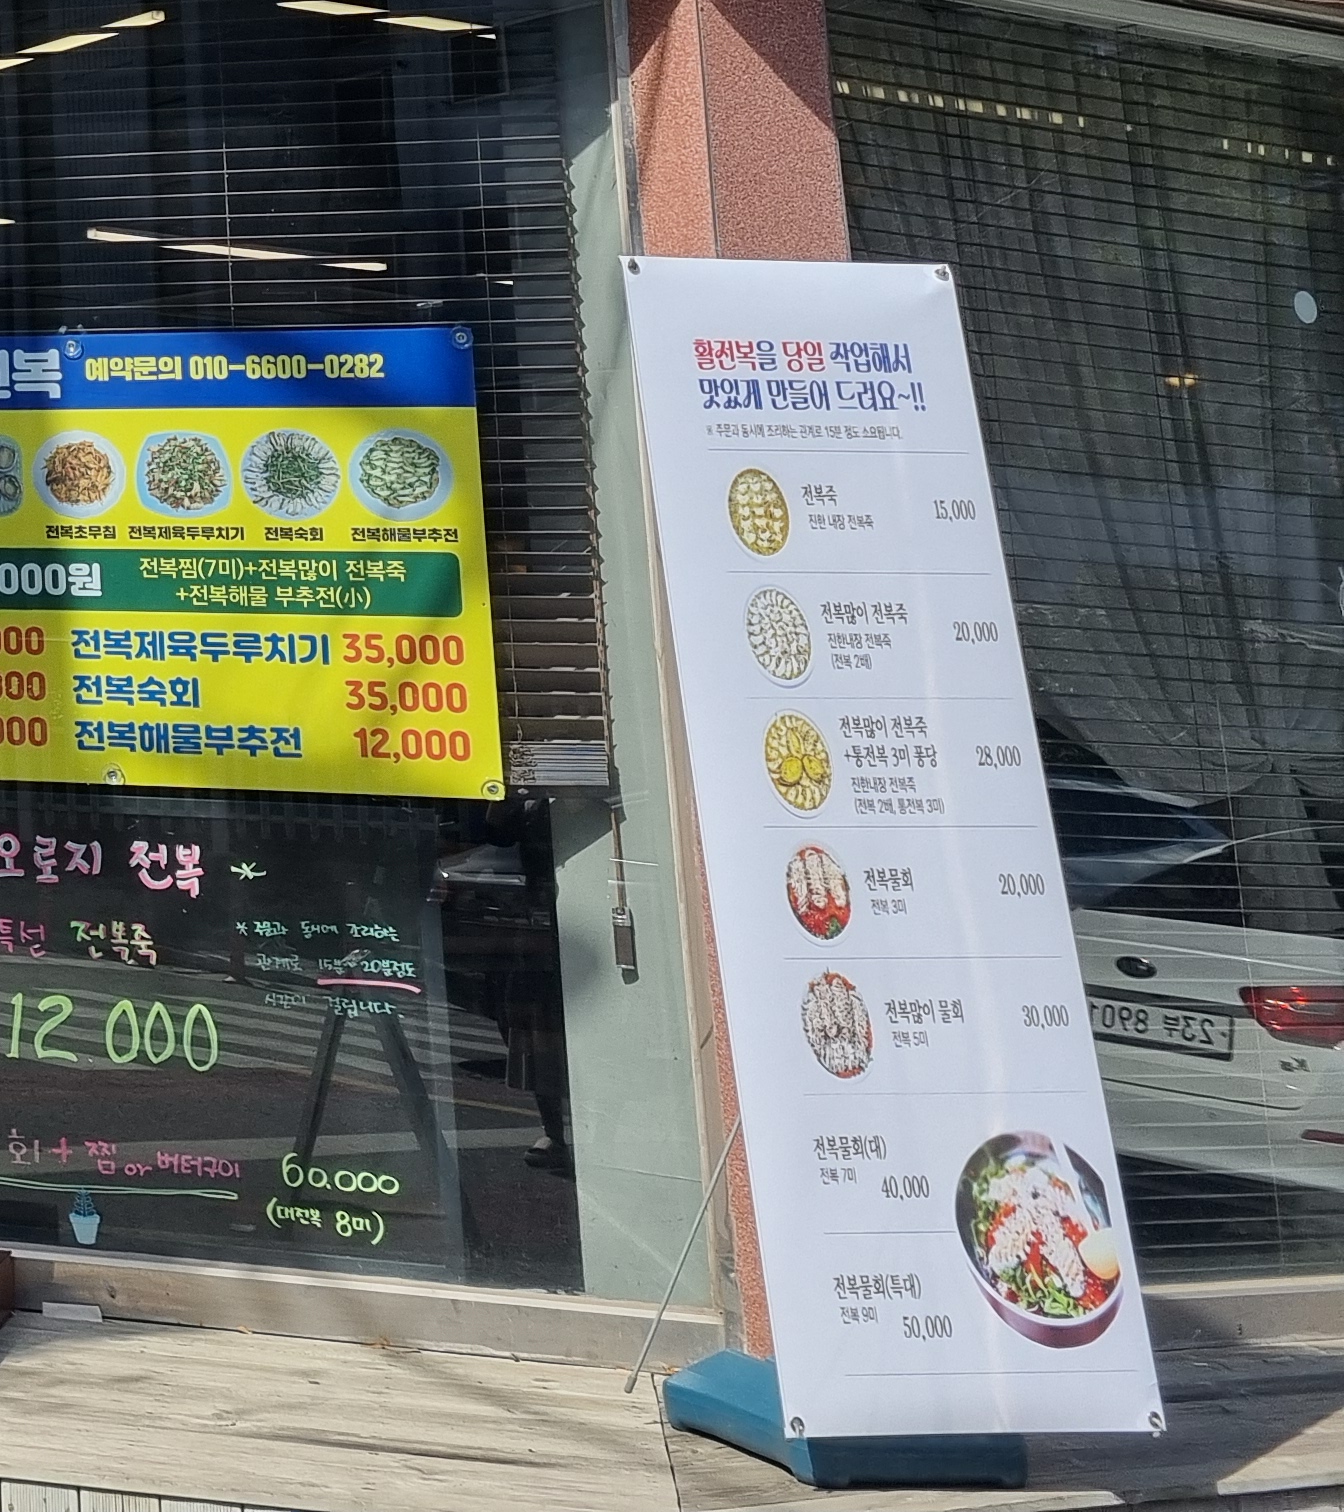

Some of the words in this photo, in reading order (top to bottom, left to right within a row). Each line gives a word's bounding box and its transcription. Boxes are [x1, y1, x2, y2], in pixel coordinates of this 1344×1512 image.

[85, 355, 182, 382] 예약문의
[190, 354, 385, 381] 010-6600-0282
[692, 338, 778, 372] 활전복을
[781, 341, 826, 373] 당일
[829, 342, 912, 374] 작업해서
[698, 378, 762, 410] 맛있게
[766, 378, 831, 411] 만들어
[837, 381, 927, 412] 드려요~!!
[800, 485, 838, 506] 전복죽
[933, 499, 977, 522] 15,000
[45, 524, 116, 540] 전복초무침
[128, 525, 245, 541] 전복제육두루치기
[264, 526, 324, 542] 전복숙회
[350, 527, 459, 544] 전복해물부추전
[847, 515, 874, 530] 전복죽
[140, 557, 339, 581] 전복찜(7미)+전복많이
[345, 559, 407, 583] 전복죽
[175, 585, 268, 607] +전복해물
[819, 602, 869, 625] 전복많이
[871, 602, 908, 625] 전복죽
[952, 621, 999, 645] 20,000
[70, 628, 331, 666] 전복제육두루치기
[342, 632, 464, 669] 35,000
[864, 633, 892, 649] 전복죽
[72, 674, 200, 709] 전복숙회
[345, 679, 468, 716] 35,000
[839, 716, 888, 738] 전복많이
[891, 717, 928, 738] 전복죽
[74, 720, 303, 759] 전복해물부추전
[353, 727, 471, 764] 12,000
[843, 745, 890, 768] +통전복
[975, 746, 1021, 770] 28,000
[128, 839, 203, 898] 전복
[863, 868, 914, 892] 전복물회
[998, 873, 1045, 898] 20,000
[71, 920, 157, 966] 전복죽
[346, 923, 400, 942] 조리하는
[884, 1000, 936, 1024] 전복많이
[938, 999, 965, 1024] 물회
[1021, 1004, 1069, 1030] 30,000
[813, 1135, 887, 1161] 전복물회(대)
[157, 1151, 241, 1179] 버터구이
[881, 1175, 930, 1201] 40,000
[833, 1272, 922, 1299] 전복물회(특대)
[903, 1315, 952, 1341] 50,000
